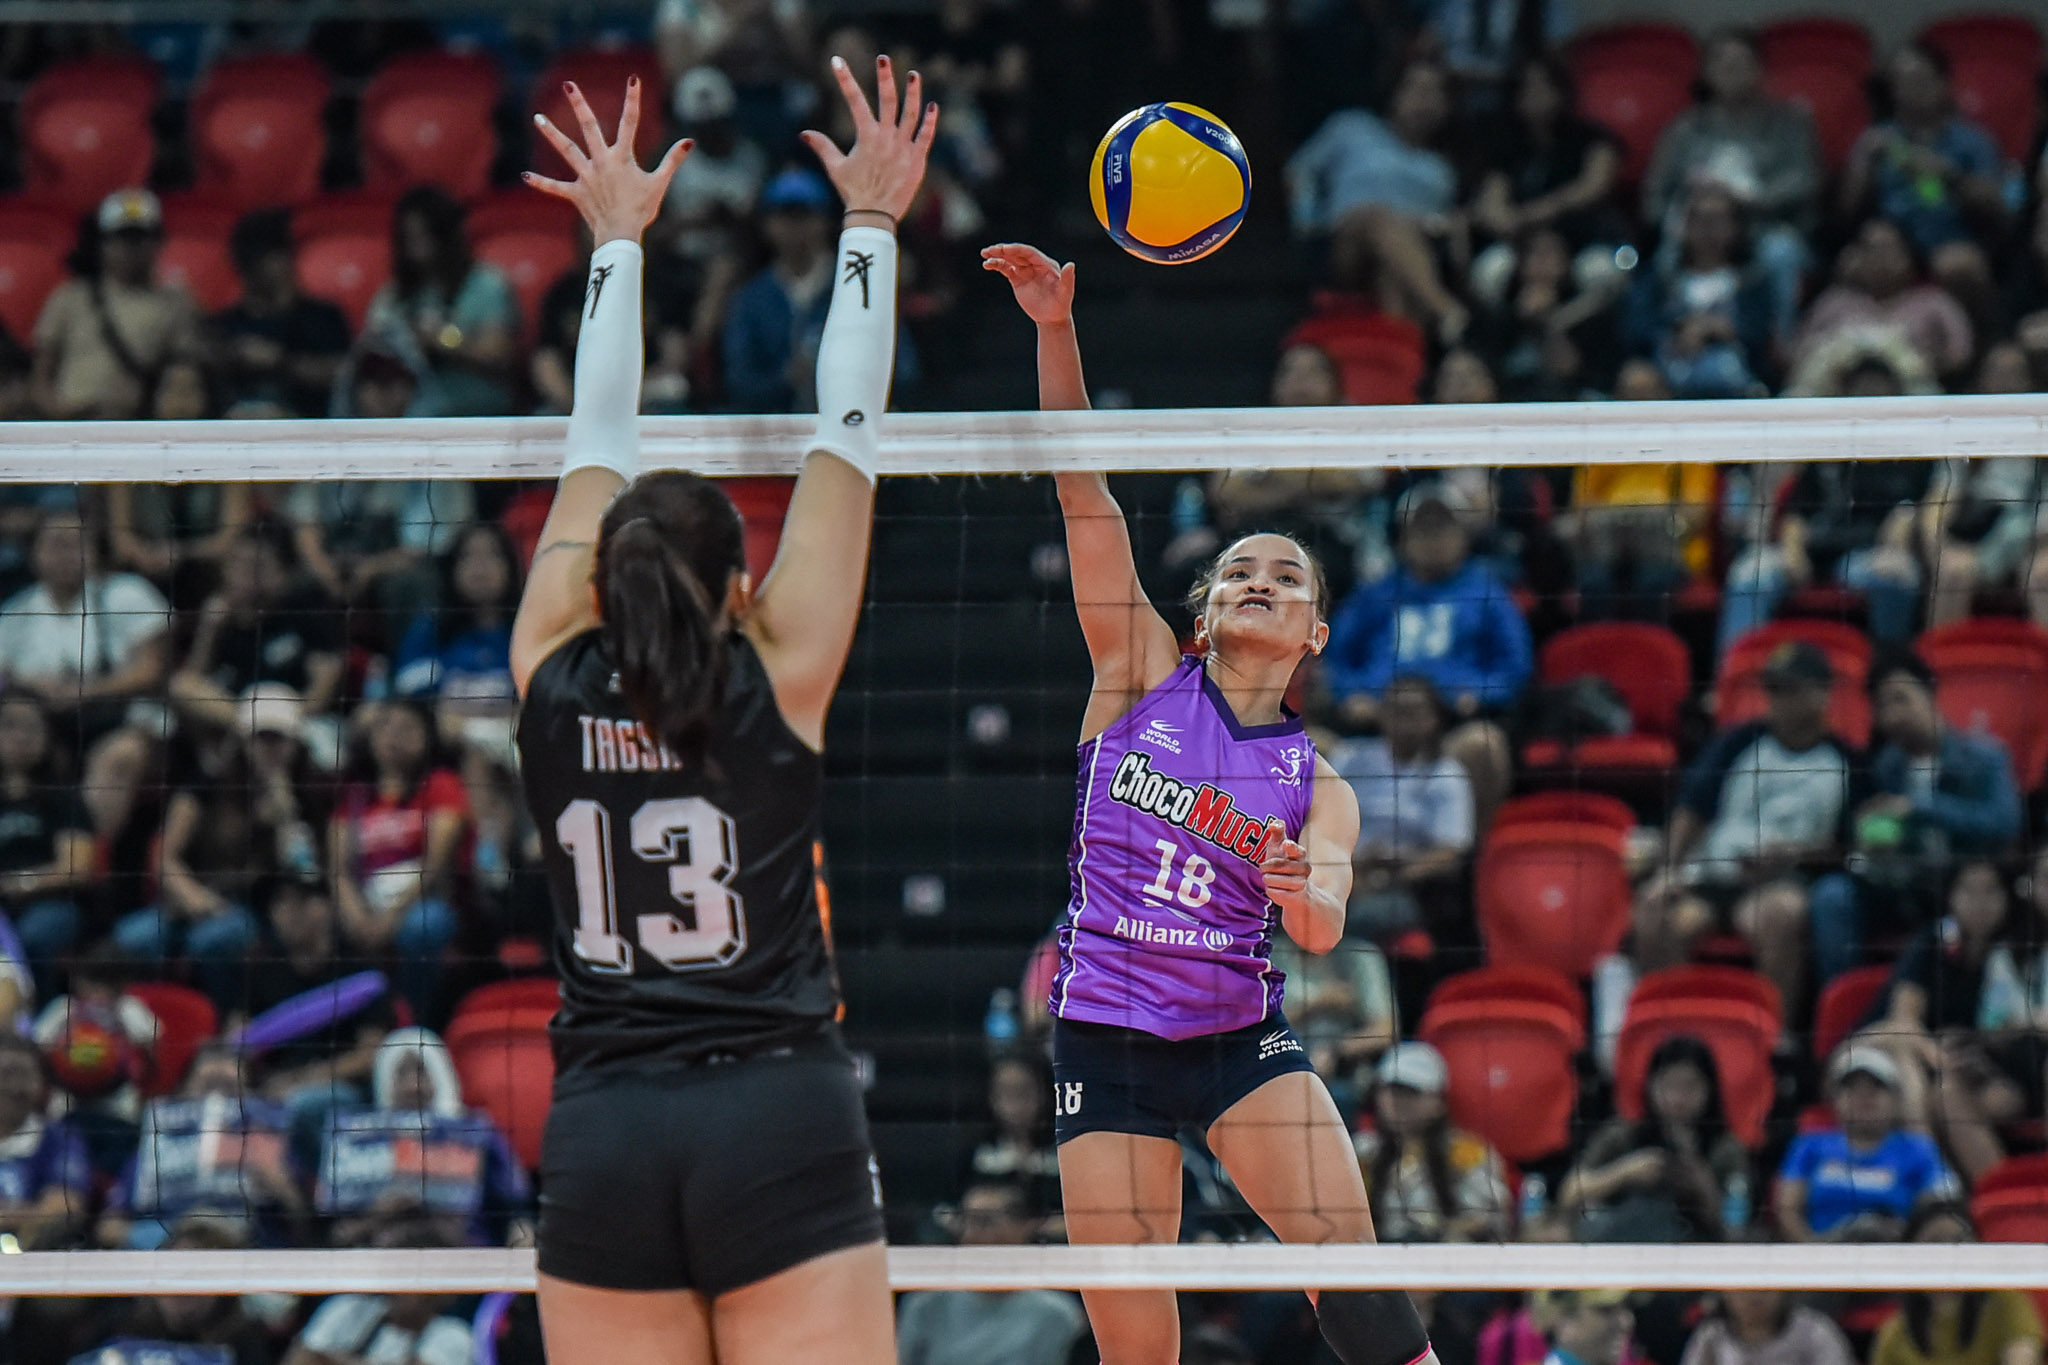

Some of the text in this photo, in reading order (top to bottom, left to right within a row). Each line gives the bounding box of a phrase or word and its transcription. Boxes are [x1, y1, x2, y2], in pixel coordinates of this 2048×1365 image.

[1205, 126, 1236, 148] V200
[1113, 153, 1123, 184] FIVB
[1139, 733, 1182, 755] BALANCE
[1146, 728, 1180, 746] WORLD
[556, 796, 748, 975] 13
[1142, 838, 1216, 908] 18
[1113, 915, 1198, 946] Allianz
[1262, 1039, 1297, 1052] WORLD
